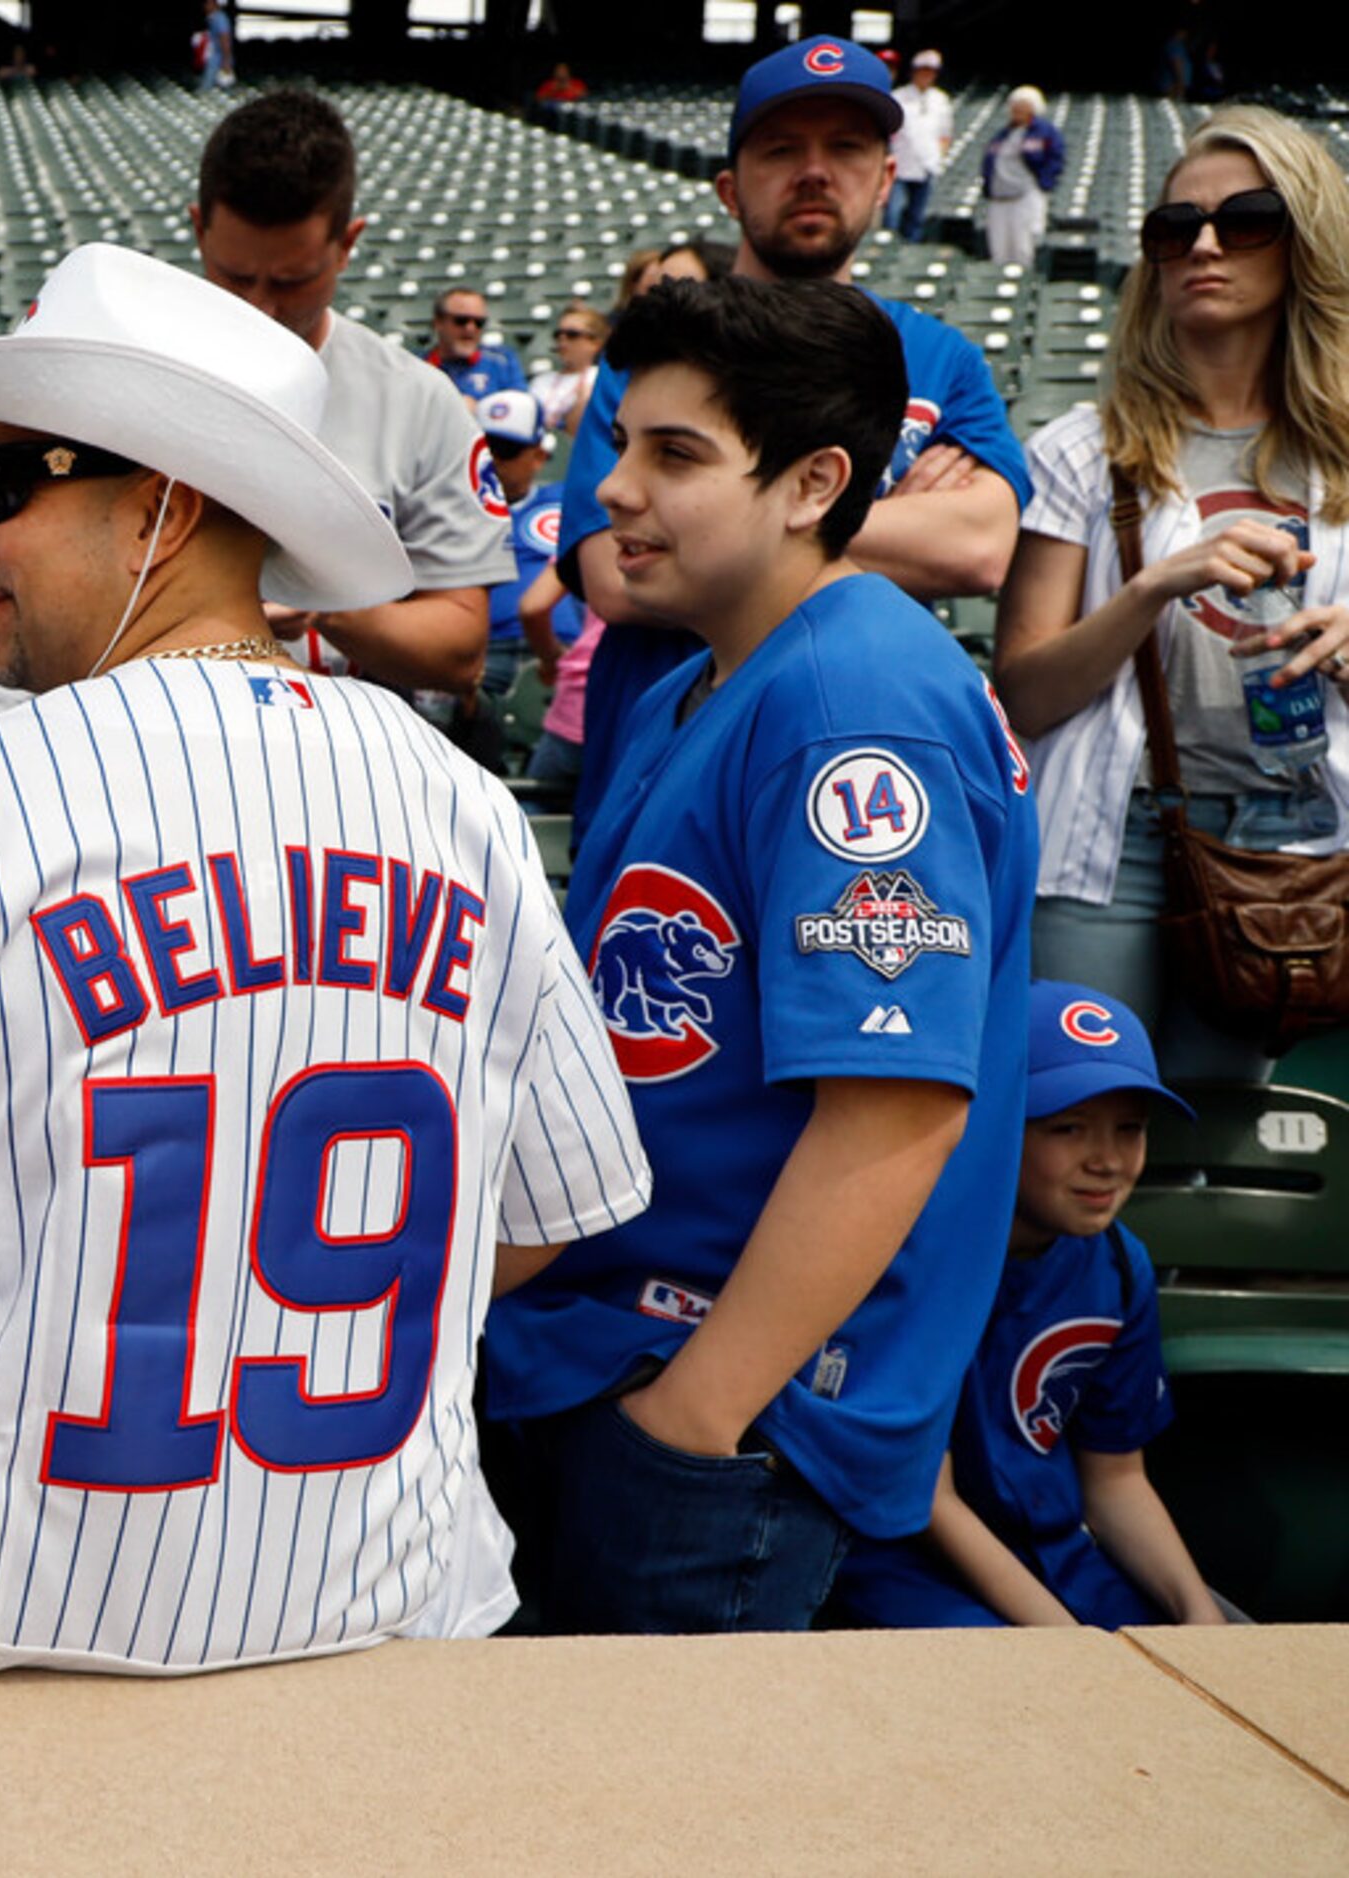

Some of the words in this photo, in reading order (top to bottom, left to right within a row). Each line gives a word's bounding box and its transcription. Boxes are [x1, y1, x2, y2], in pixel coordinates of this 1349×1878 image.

[803, 43, 844, 76] C
[832, 771, 907, 843] 14
[28, 845, 486, 1048] BELIEVE
[801, 918, 970, 950] POSTSEASON
[1060, 1000, 1121, 1047] C
[1278, 1117, 1306, 1145] 11
[39, 1058, 459, 1494] 19
